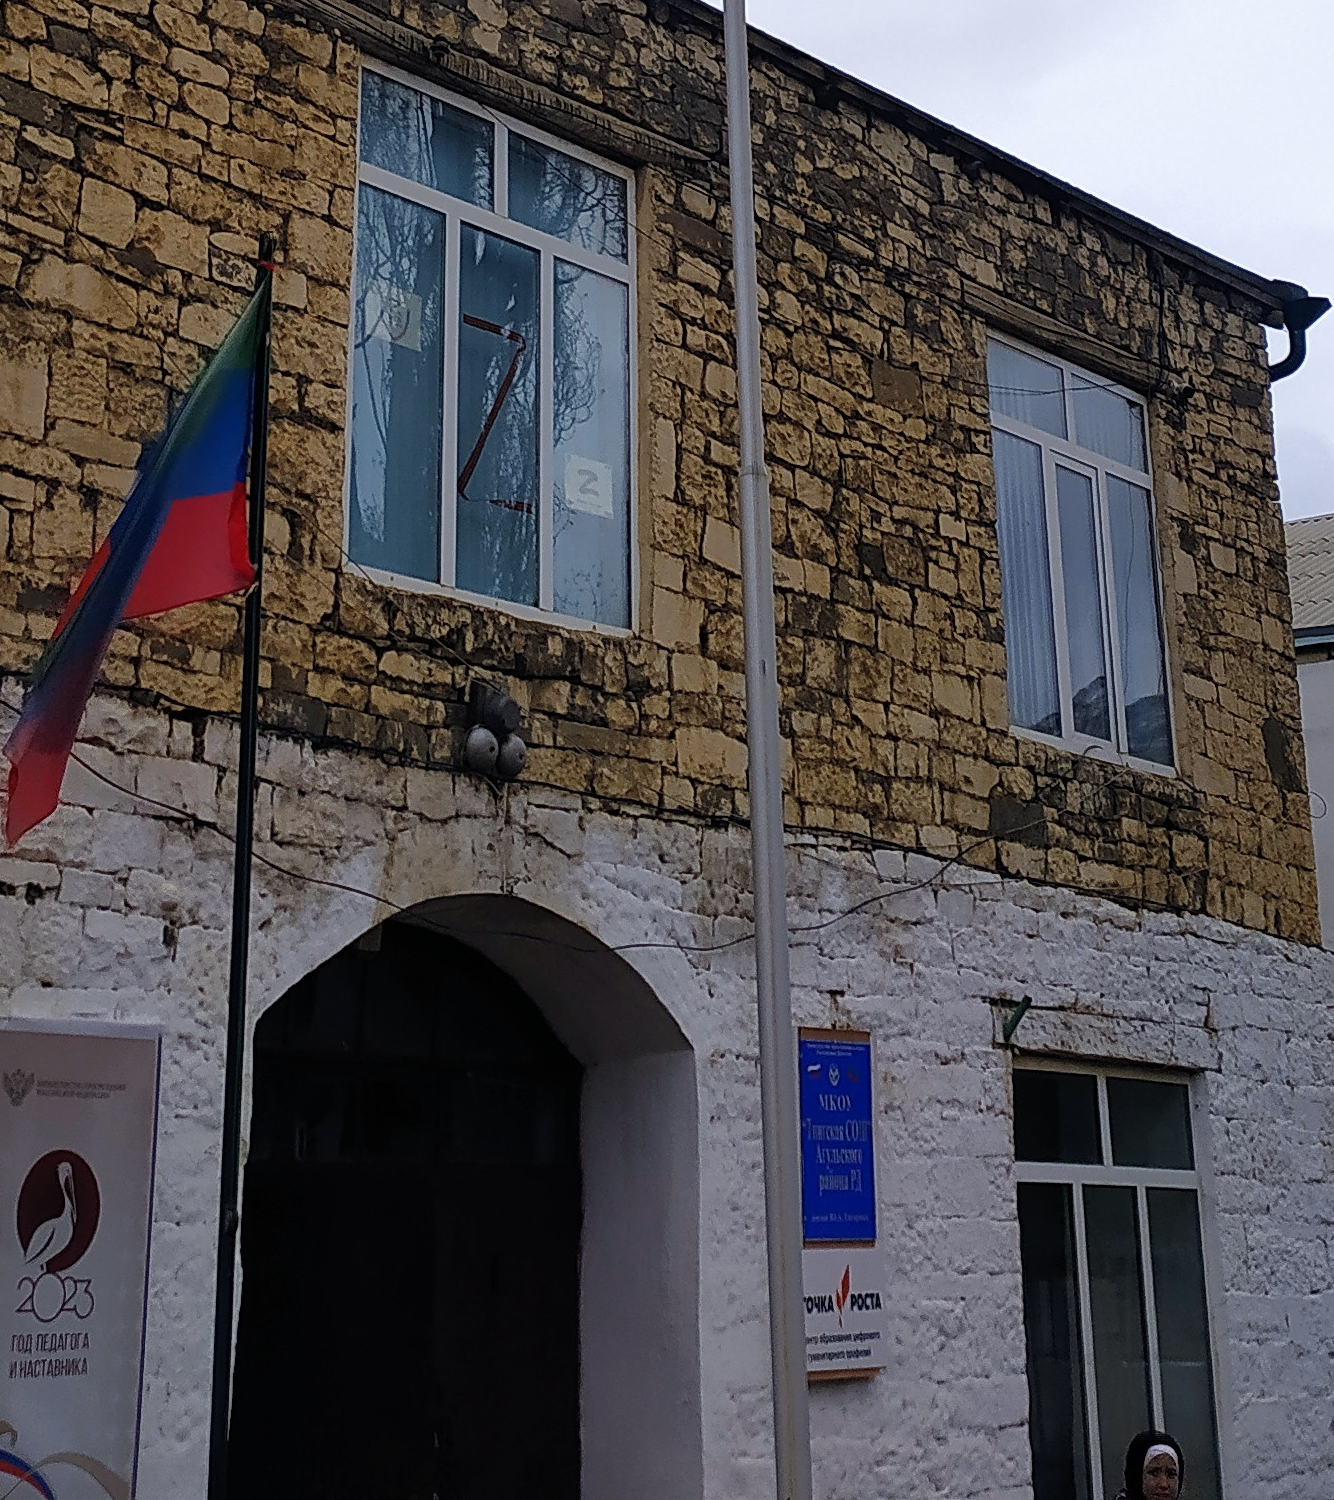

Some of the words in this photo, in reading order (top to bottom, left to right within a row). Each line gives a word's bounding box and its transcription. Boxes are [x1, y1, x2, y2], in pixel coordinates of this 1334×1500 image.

[15, 1270, 96, 1324] 2023
[850, 1292, 882, 1311] РОСТА
[10, 1333, 34, 1354] ГОД
[35, 1332, 90, 1352] ПЕДАГОГА
[9, 1361, 18, 1379] И
[19, 1357, 88, 1379] НАСТАВНИКА
